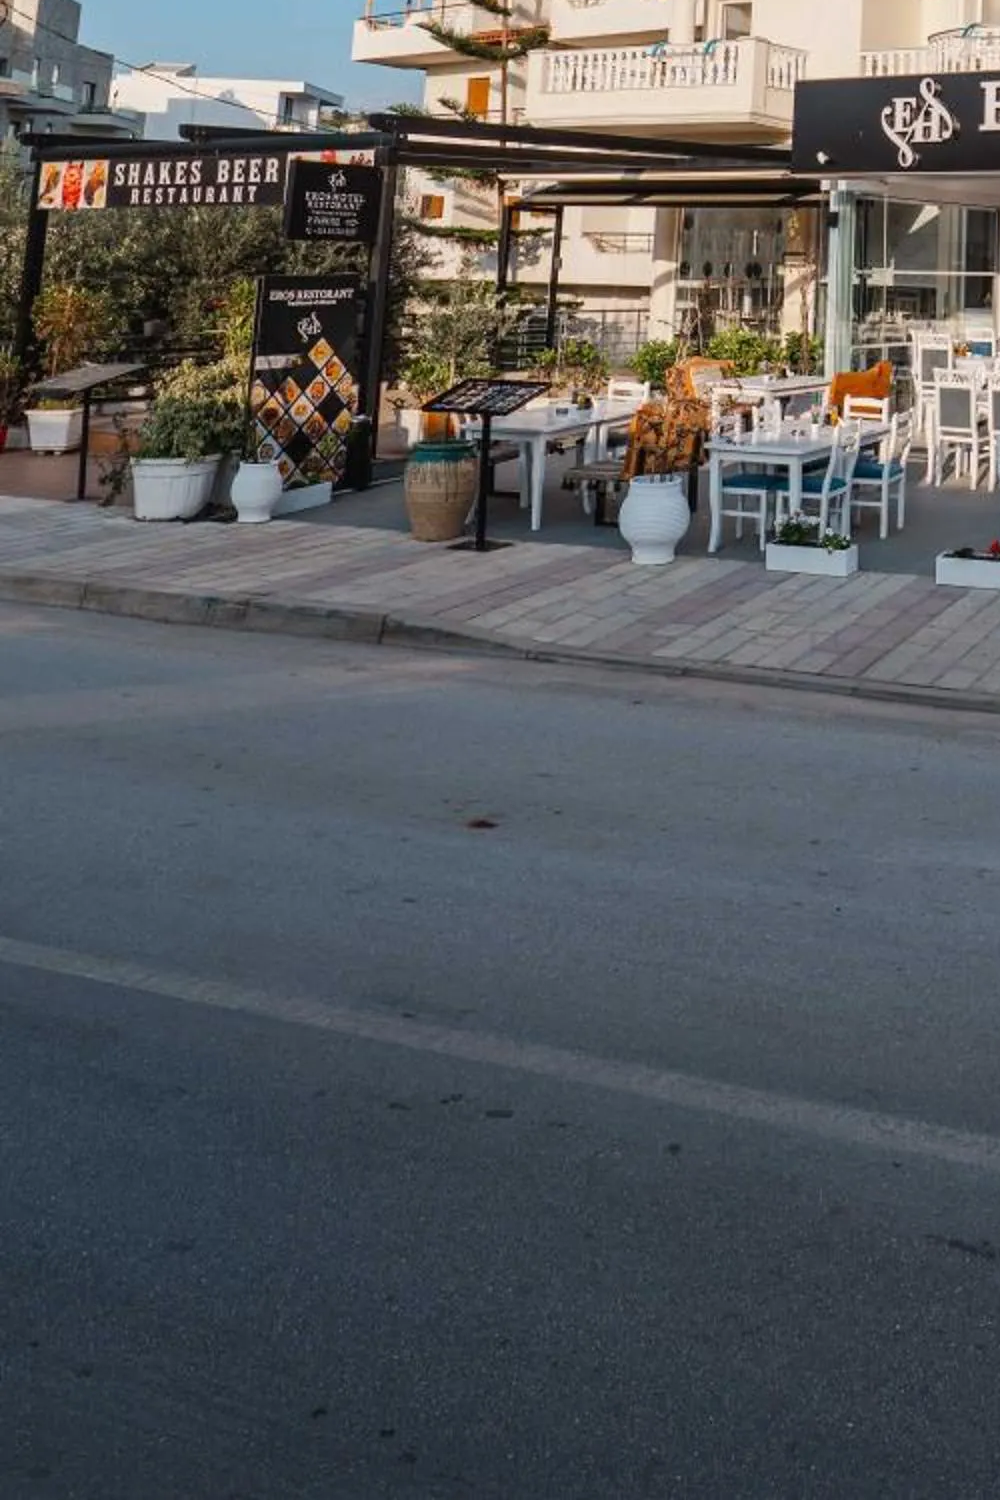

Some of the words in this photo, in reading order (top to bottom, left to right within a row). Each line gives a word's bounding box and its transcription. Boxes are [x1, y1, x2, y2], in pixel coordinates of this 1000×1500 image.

[113, 160, 203, 187] SHAKES
[216, 157, 279, 184] BEER
[130, 185, 258, 205] RESTAURANT
